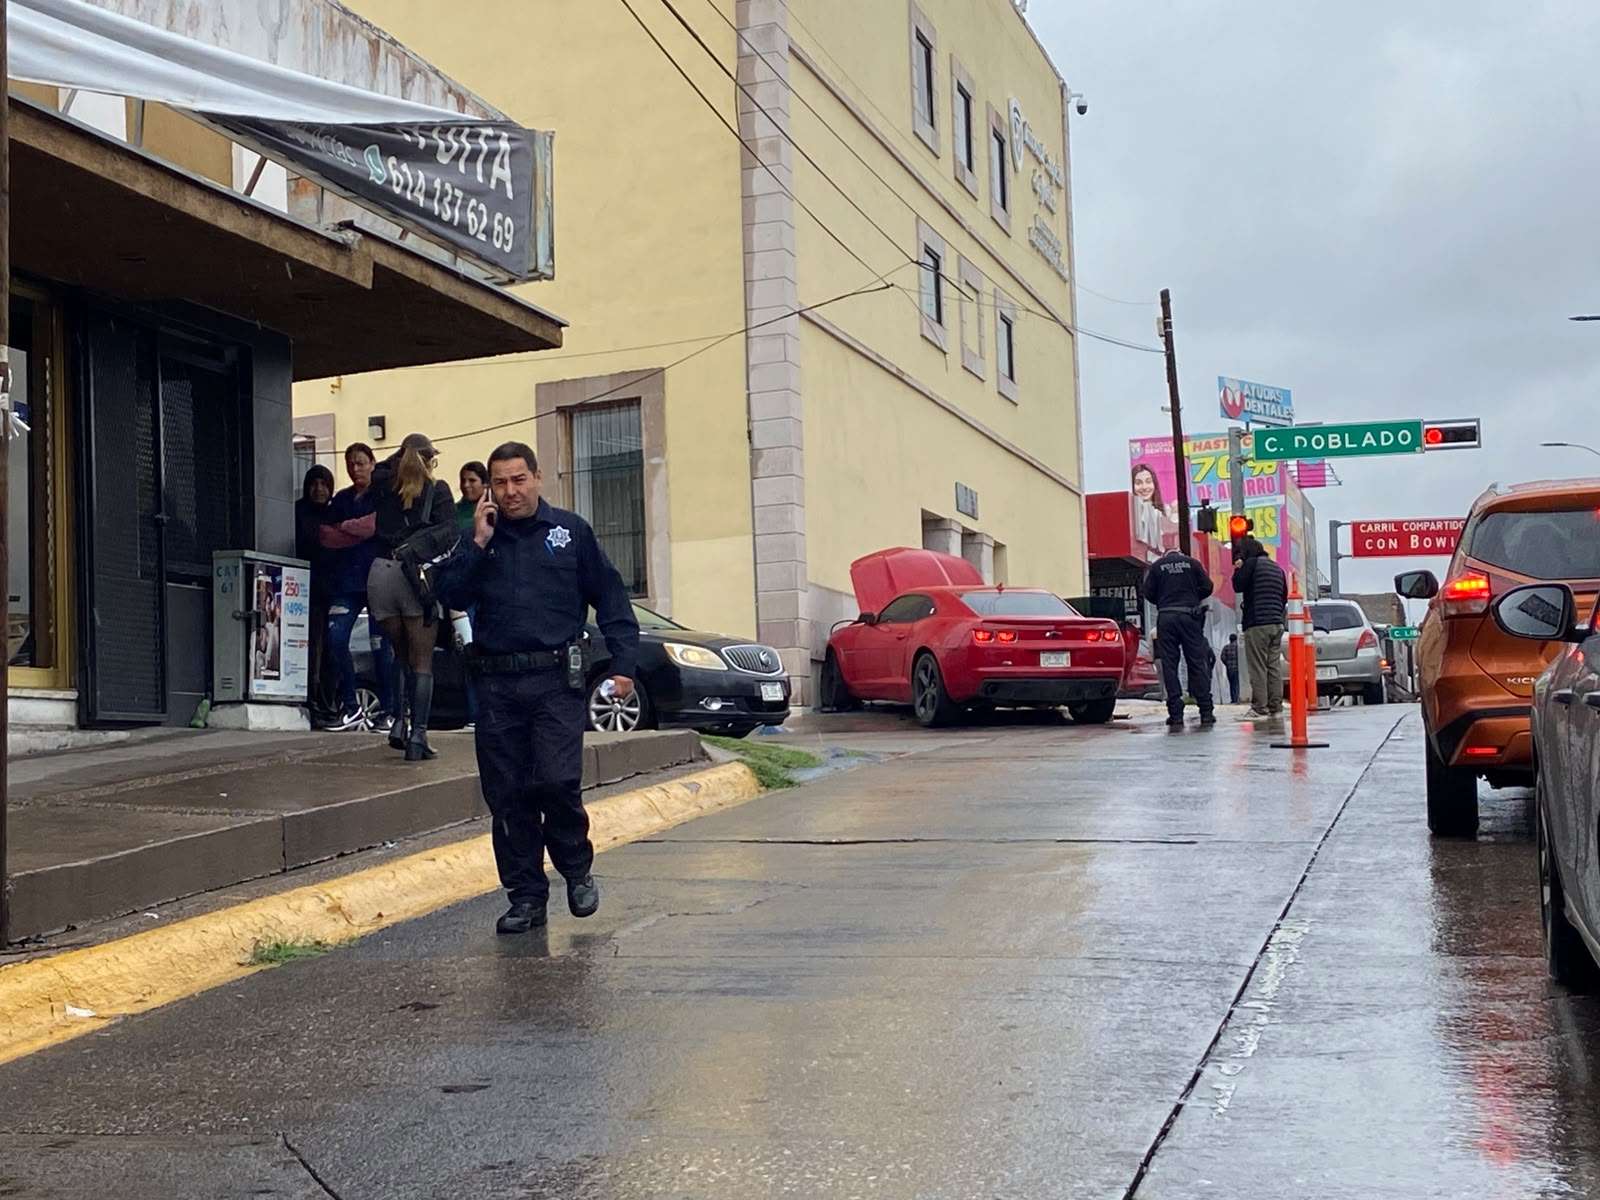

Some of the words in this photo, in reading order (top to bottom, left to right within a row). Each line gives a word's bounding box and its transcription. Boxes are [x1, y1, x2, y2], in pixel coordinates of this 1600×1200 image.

[388, 155, 426, 207] 614
[434, 177, 463, 226] 137
[467, 198, 488, 242] 62
[493, 212, 514, 252] 69
[1244, 383, 1283, 402] AYUDAS
[1244, 399, 1295, 417] DENTALES
[1193, 437, 1229, 452] HAST
[1265, 437, 1284, 452] C.
[1294, 429, 1412, 450] DOBLADO
[1360, 522, 1398, 533] CARRIL
[1365, 538, 1398, 549] CON
[216, 565, 239, 577] CAT
